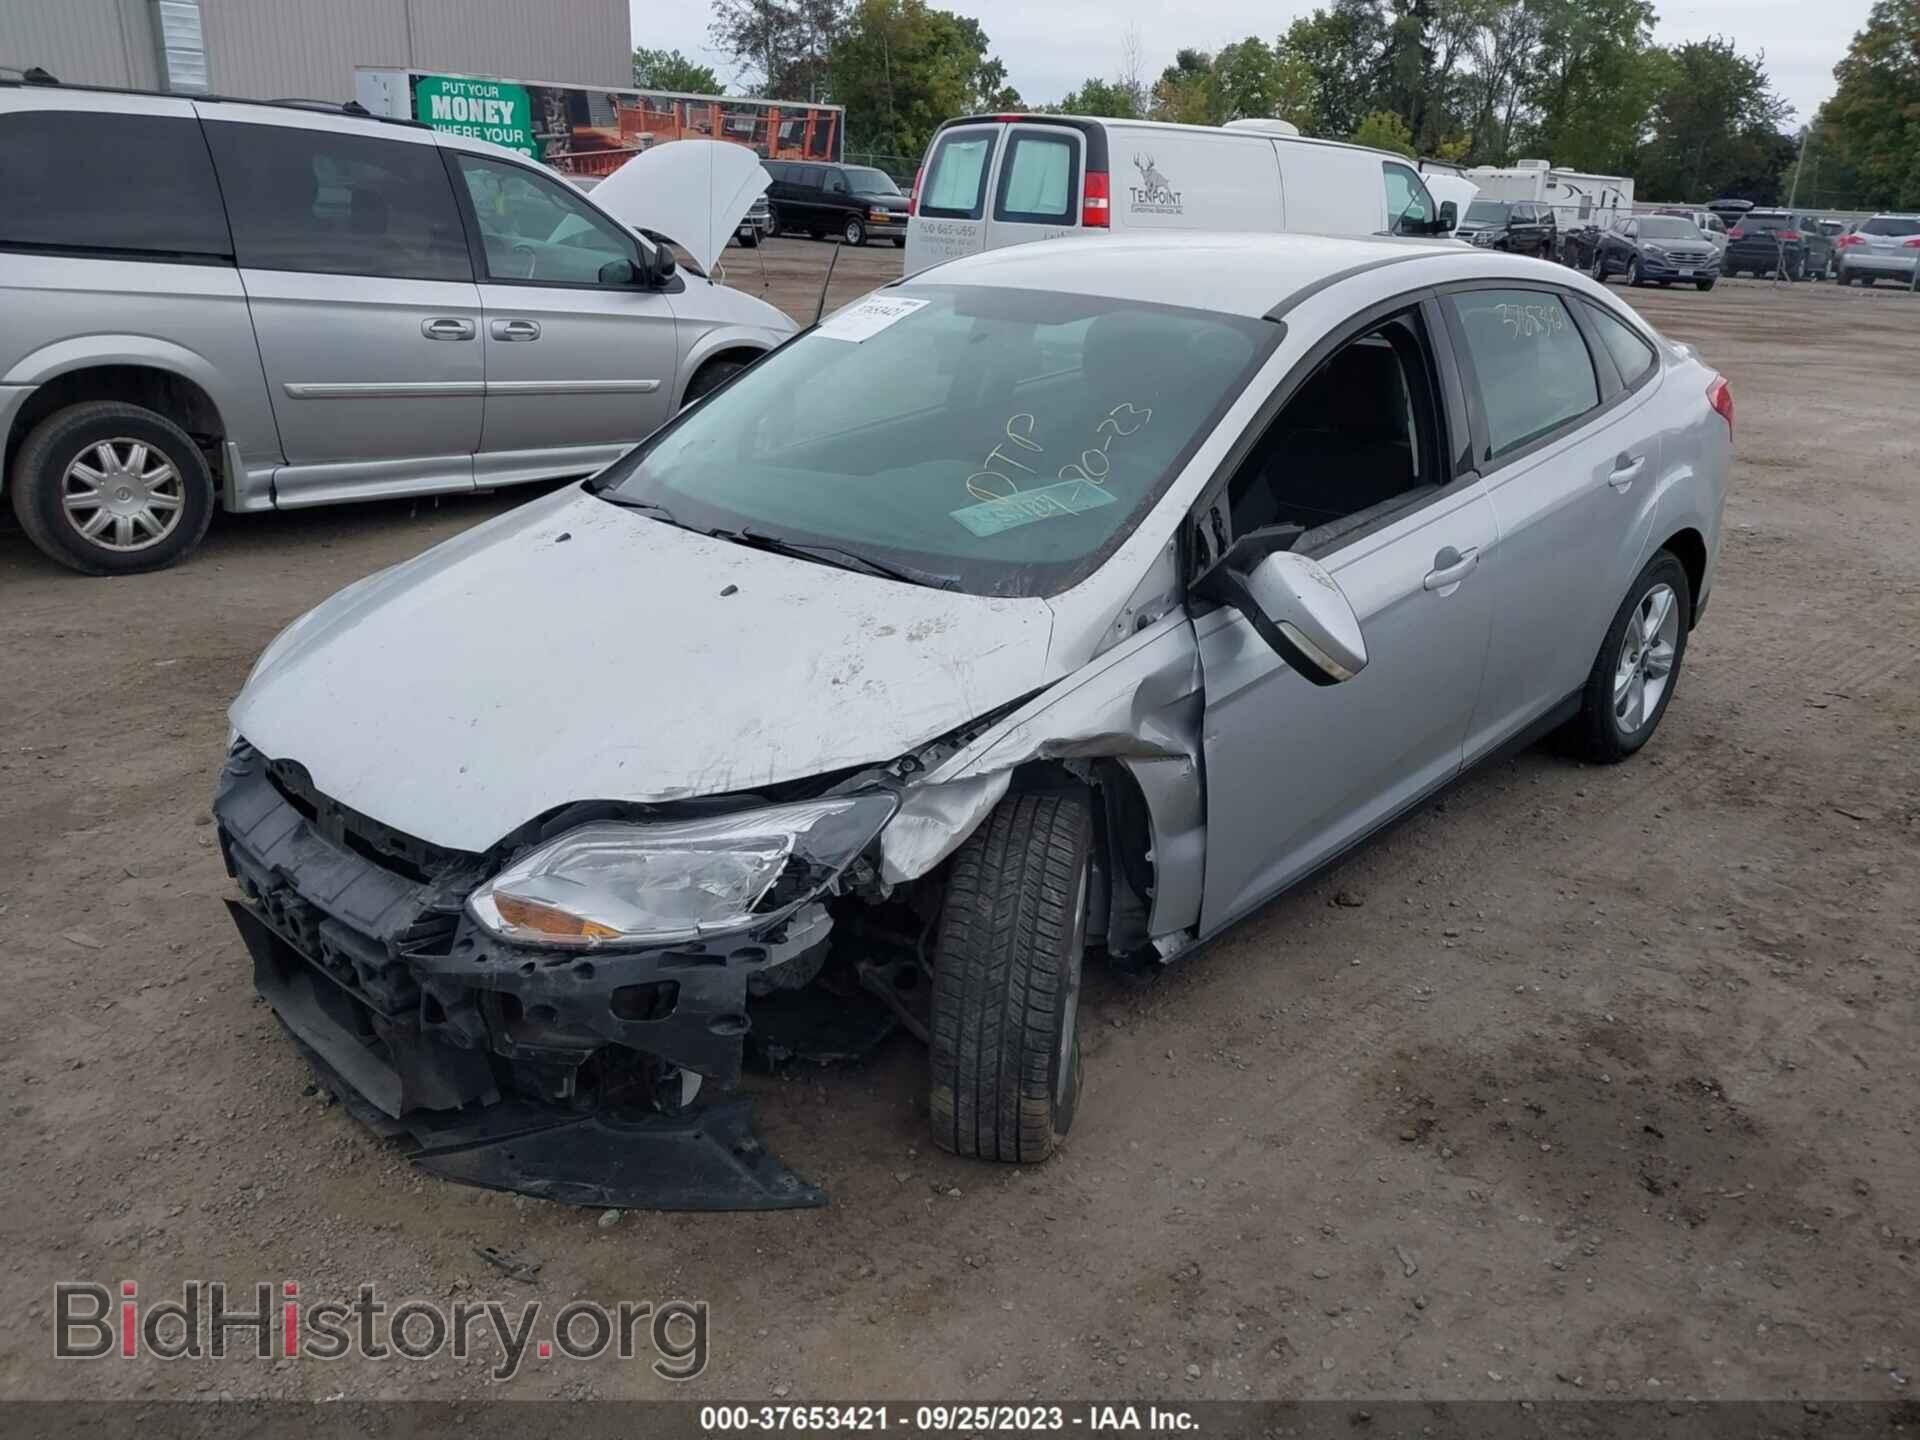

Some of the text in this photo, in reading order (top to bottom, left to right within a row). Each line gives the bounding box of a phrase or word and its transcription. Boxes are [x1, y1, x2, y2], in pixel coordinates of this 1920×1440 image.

[442, 81, 499, 98] PUT YOUR
[431, 94, 514, 125] MONEY
[483, 127, 524, 143] YOUR
